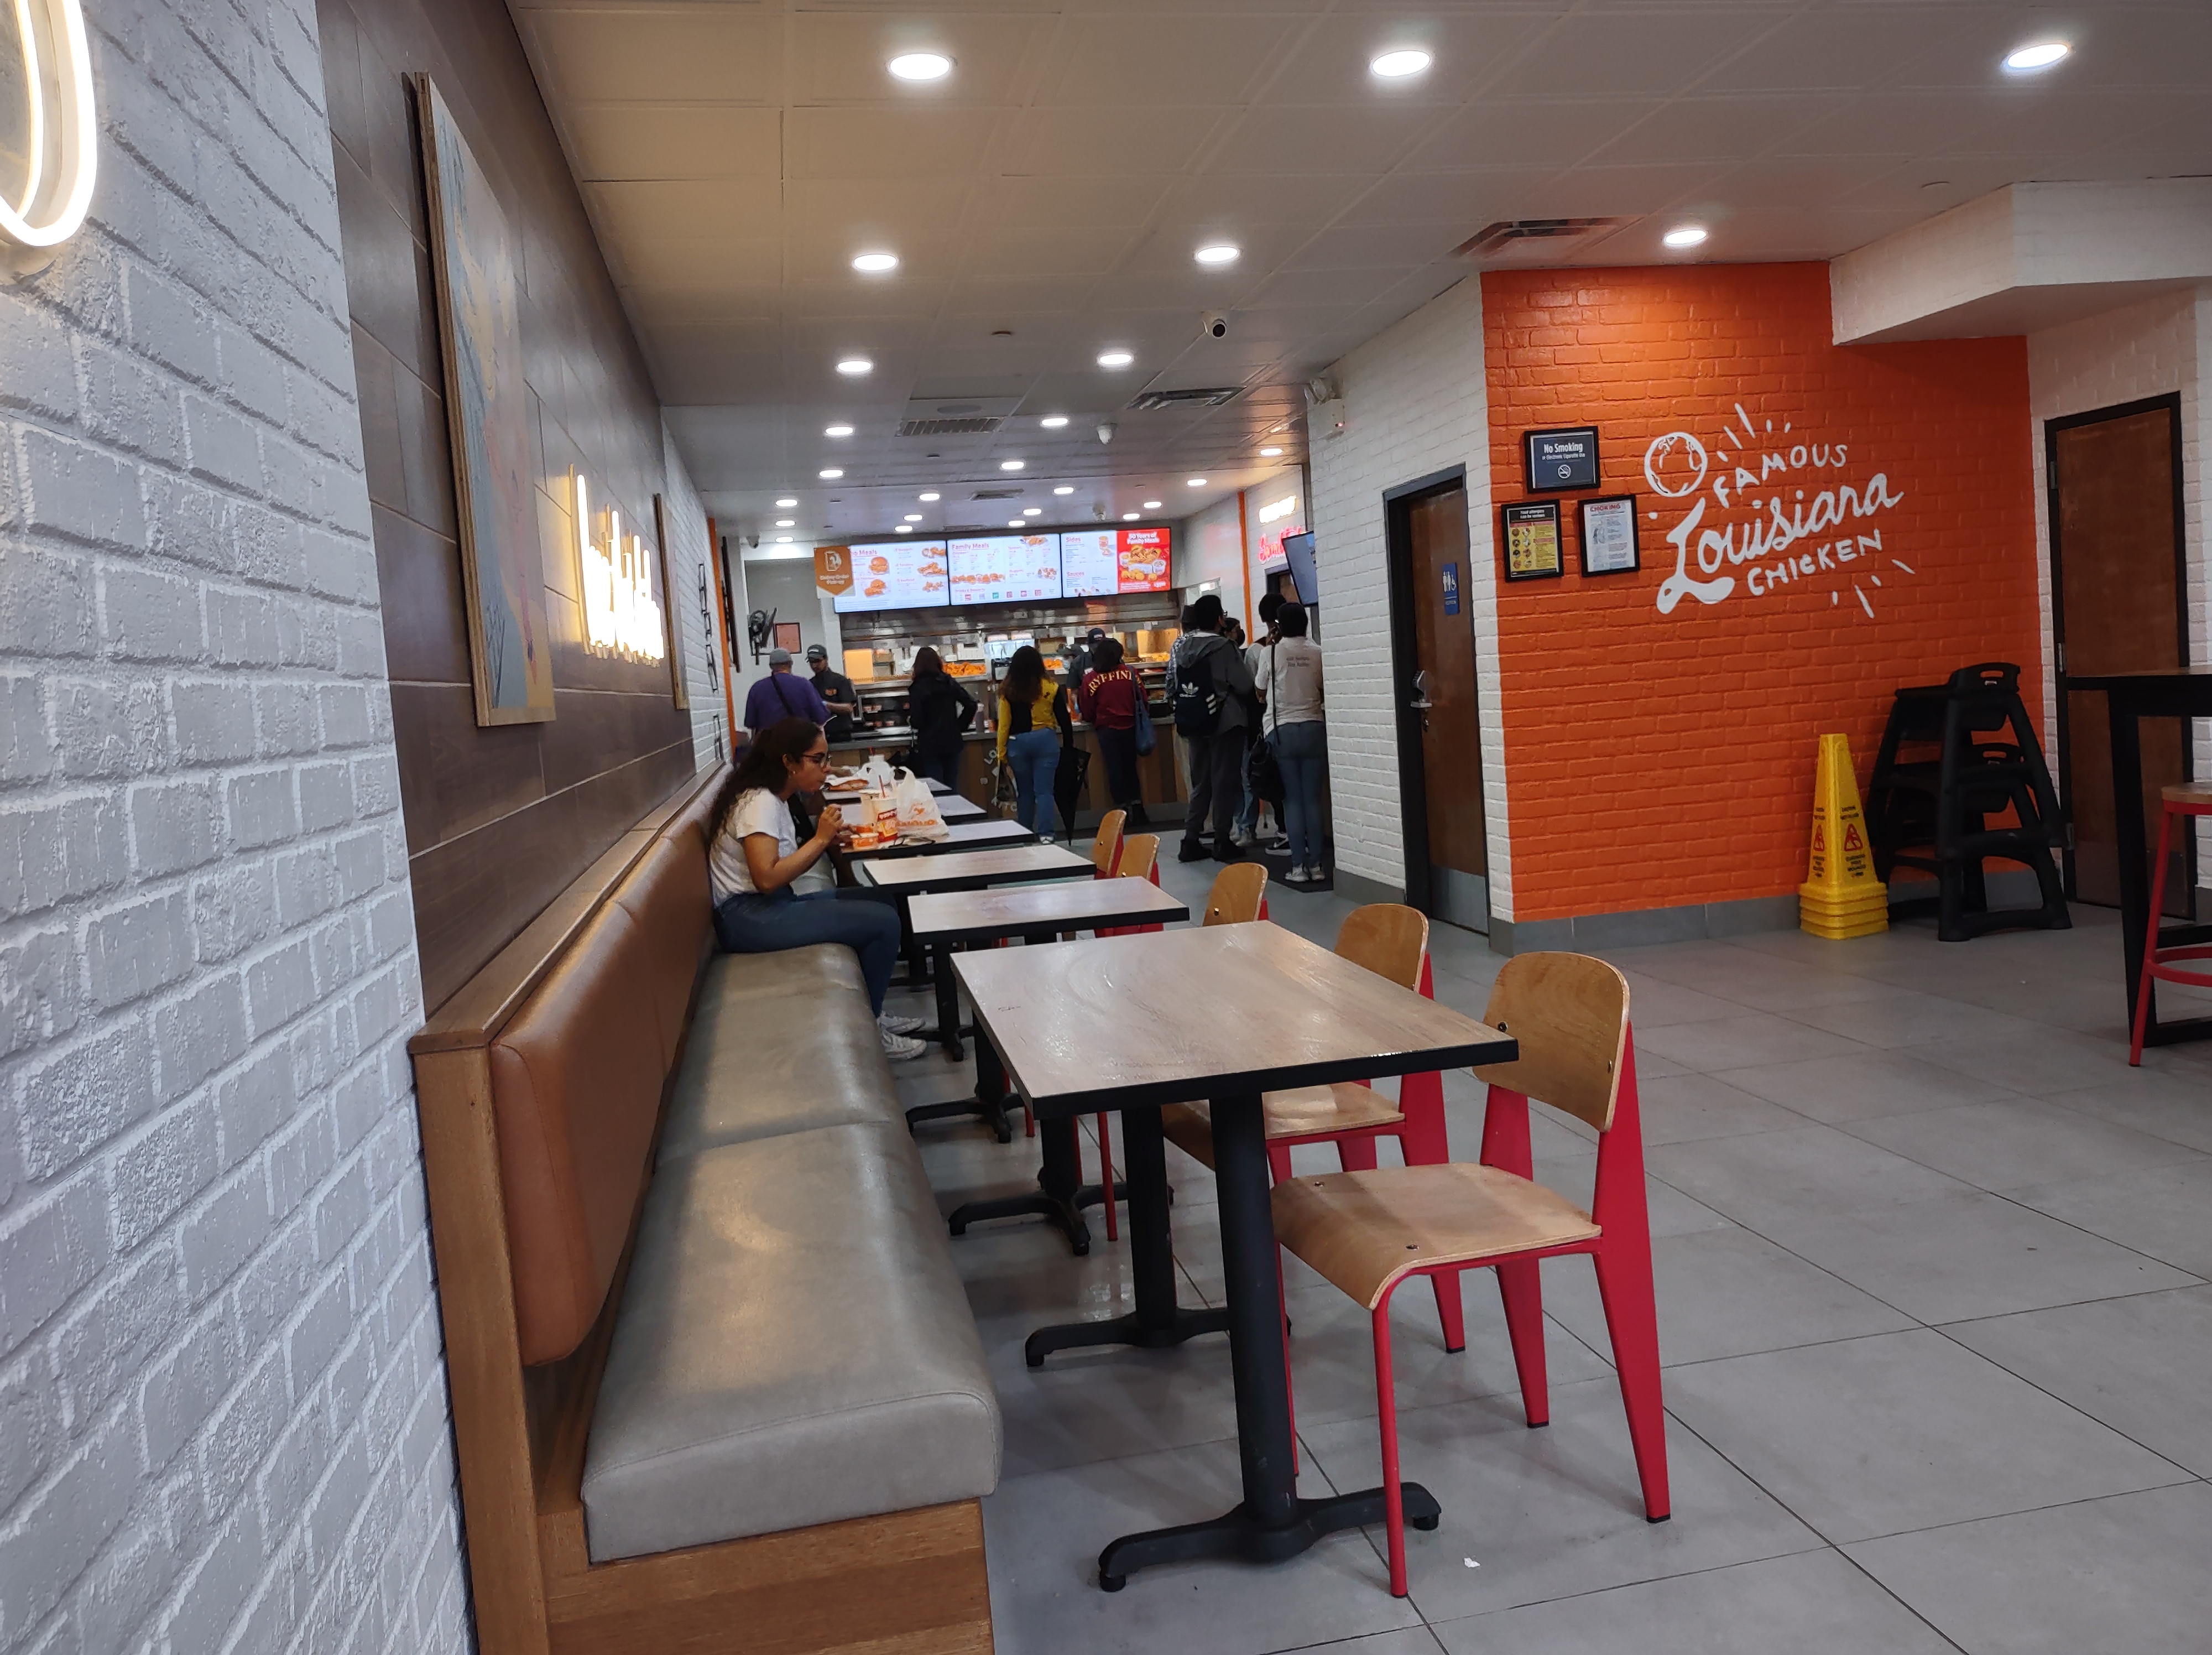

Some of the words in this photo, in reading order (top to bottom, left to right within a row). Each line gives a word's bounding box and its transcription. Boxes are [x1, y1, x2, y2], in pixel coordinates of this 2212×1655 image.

[1543, 444, 1553, 454] No
[1554, 442, 1583, 453] Smoking
[1713, 443, 1848, 508] FAMOUS
[1656, 472, 1905, 614] Louisiana
[1747, 528, 1882, 596] CHICKEN
